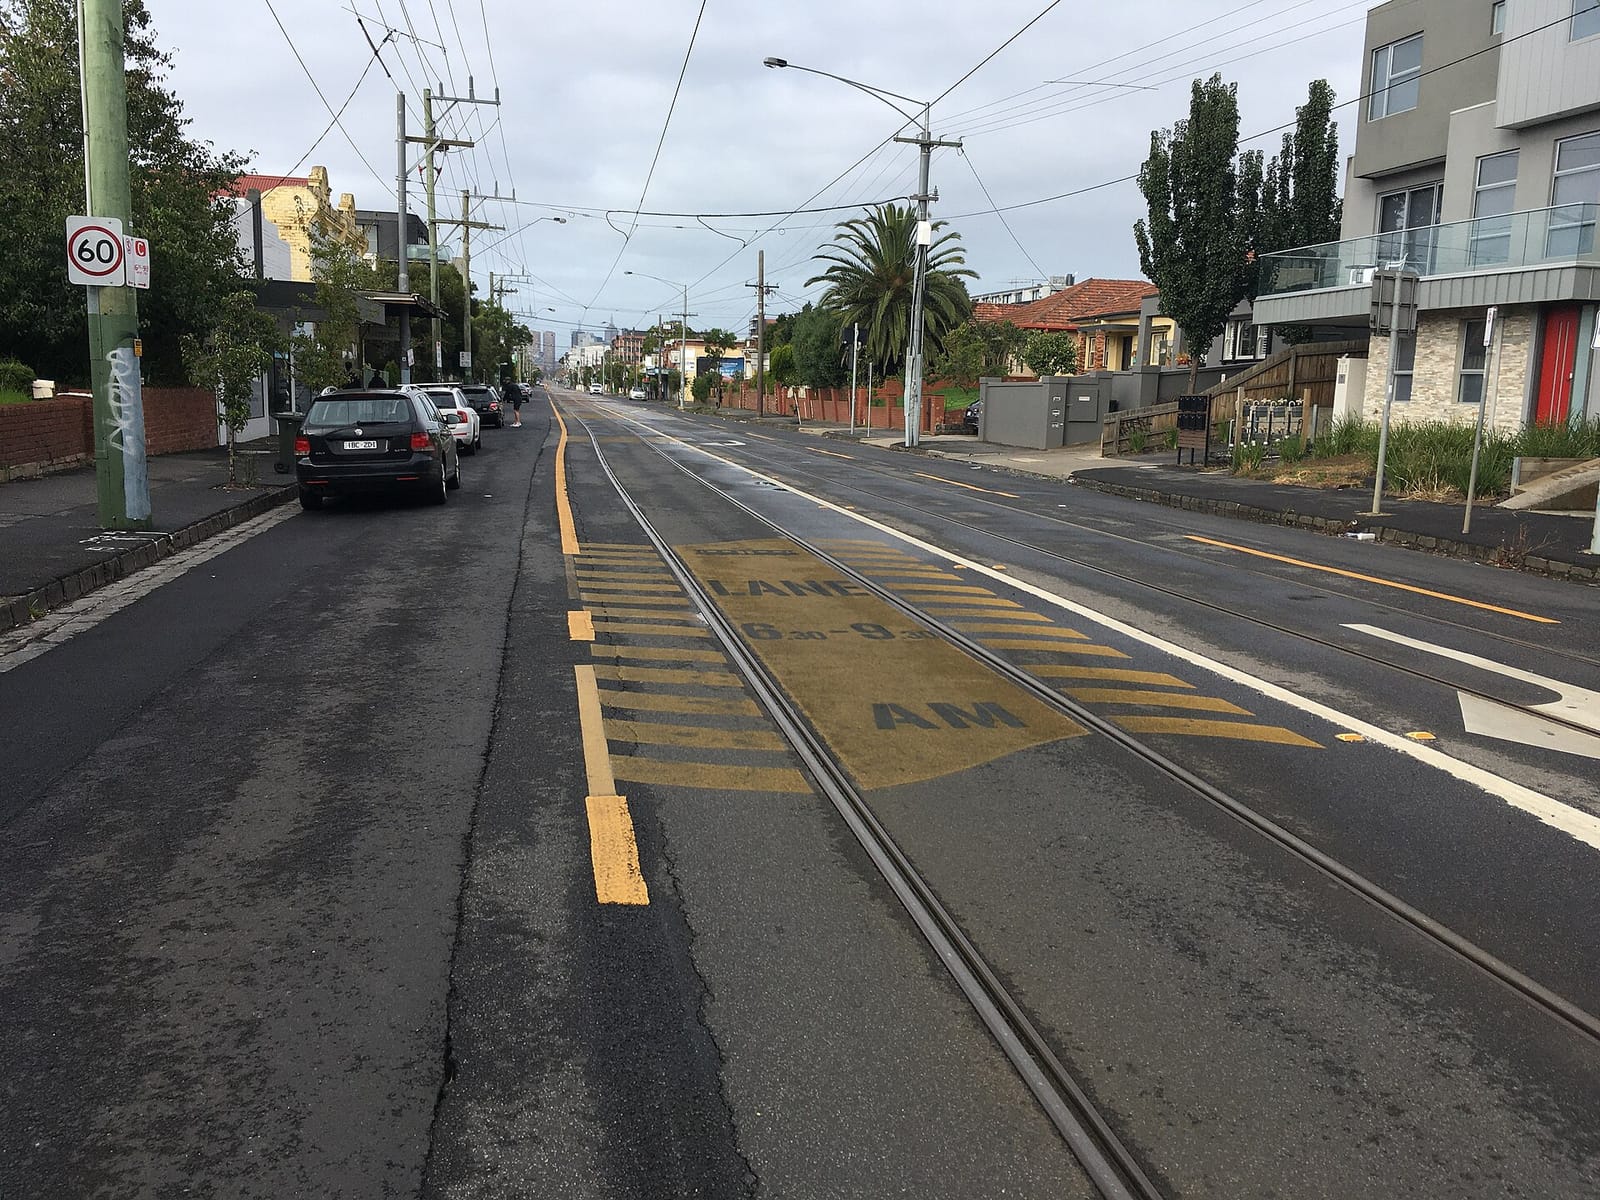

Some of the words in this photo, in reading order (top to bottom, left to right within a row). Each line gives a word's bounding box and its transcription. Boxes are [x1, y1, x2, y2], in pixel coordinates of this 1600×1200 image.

[78, 239, 114, 263] 60
[706, 580, 871, 596] LANE
[872, 702, 1031, 729] AM
